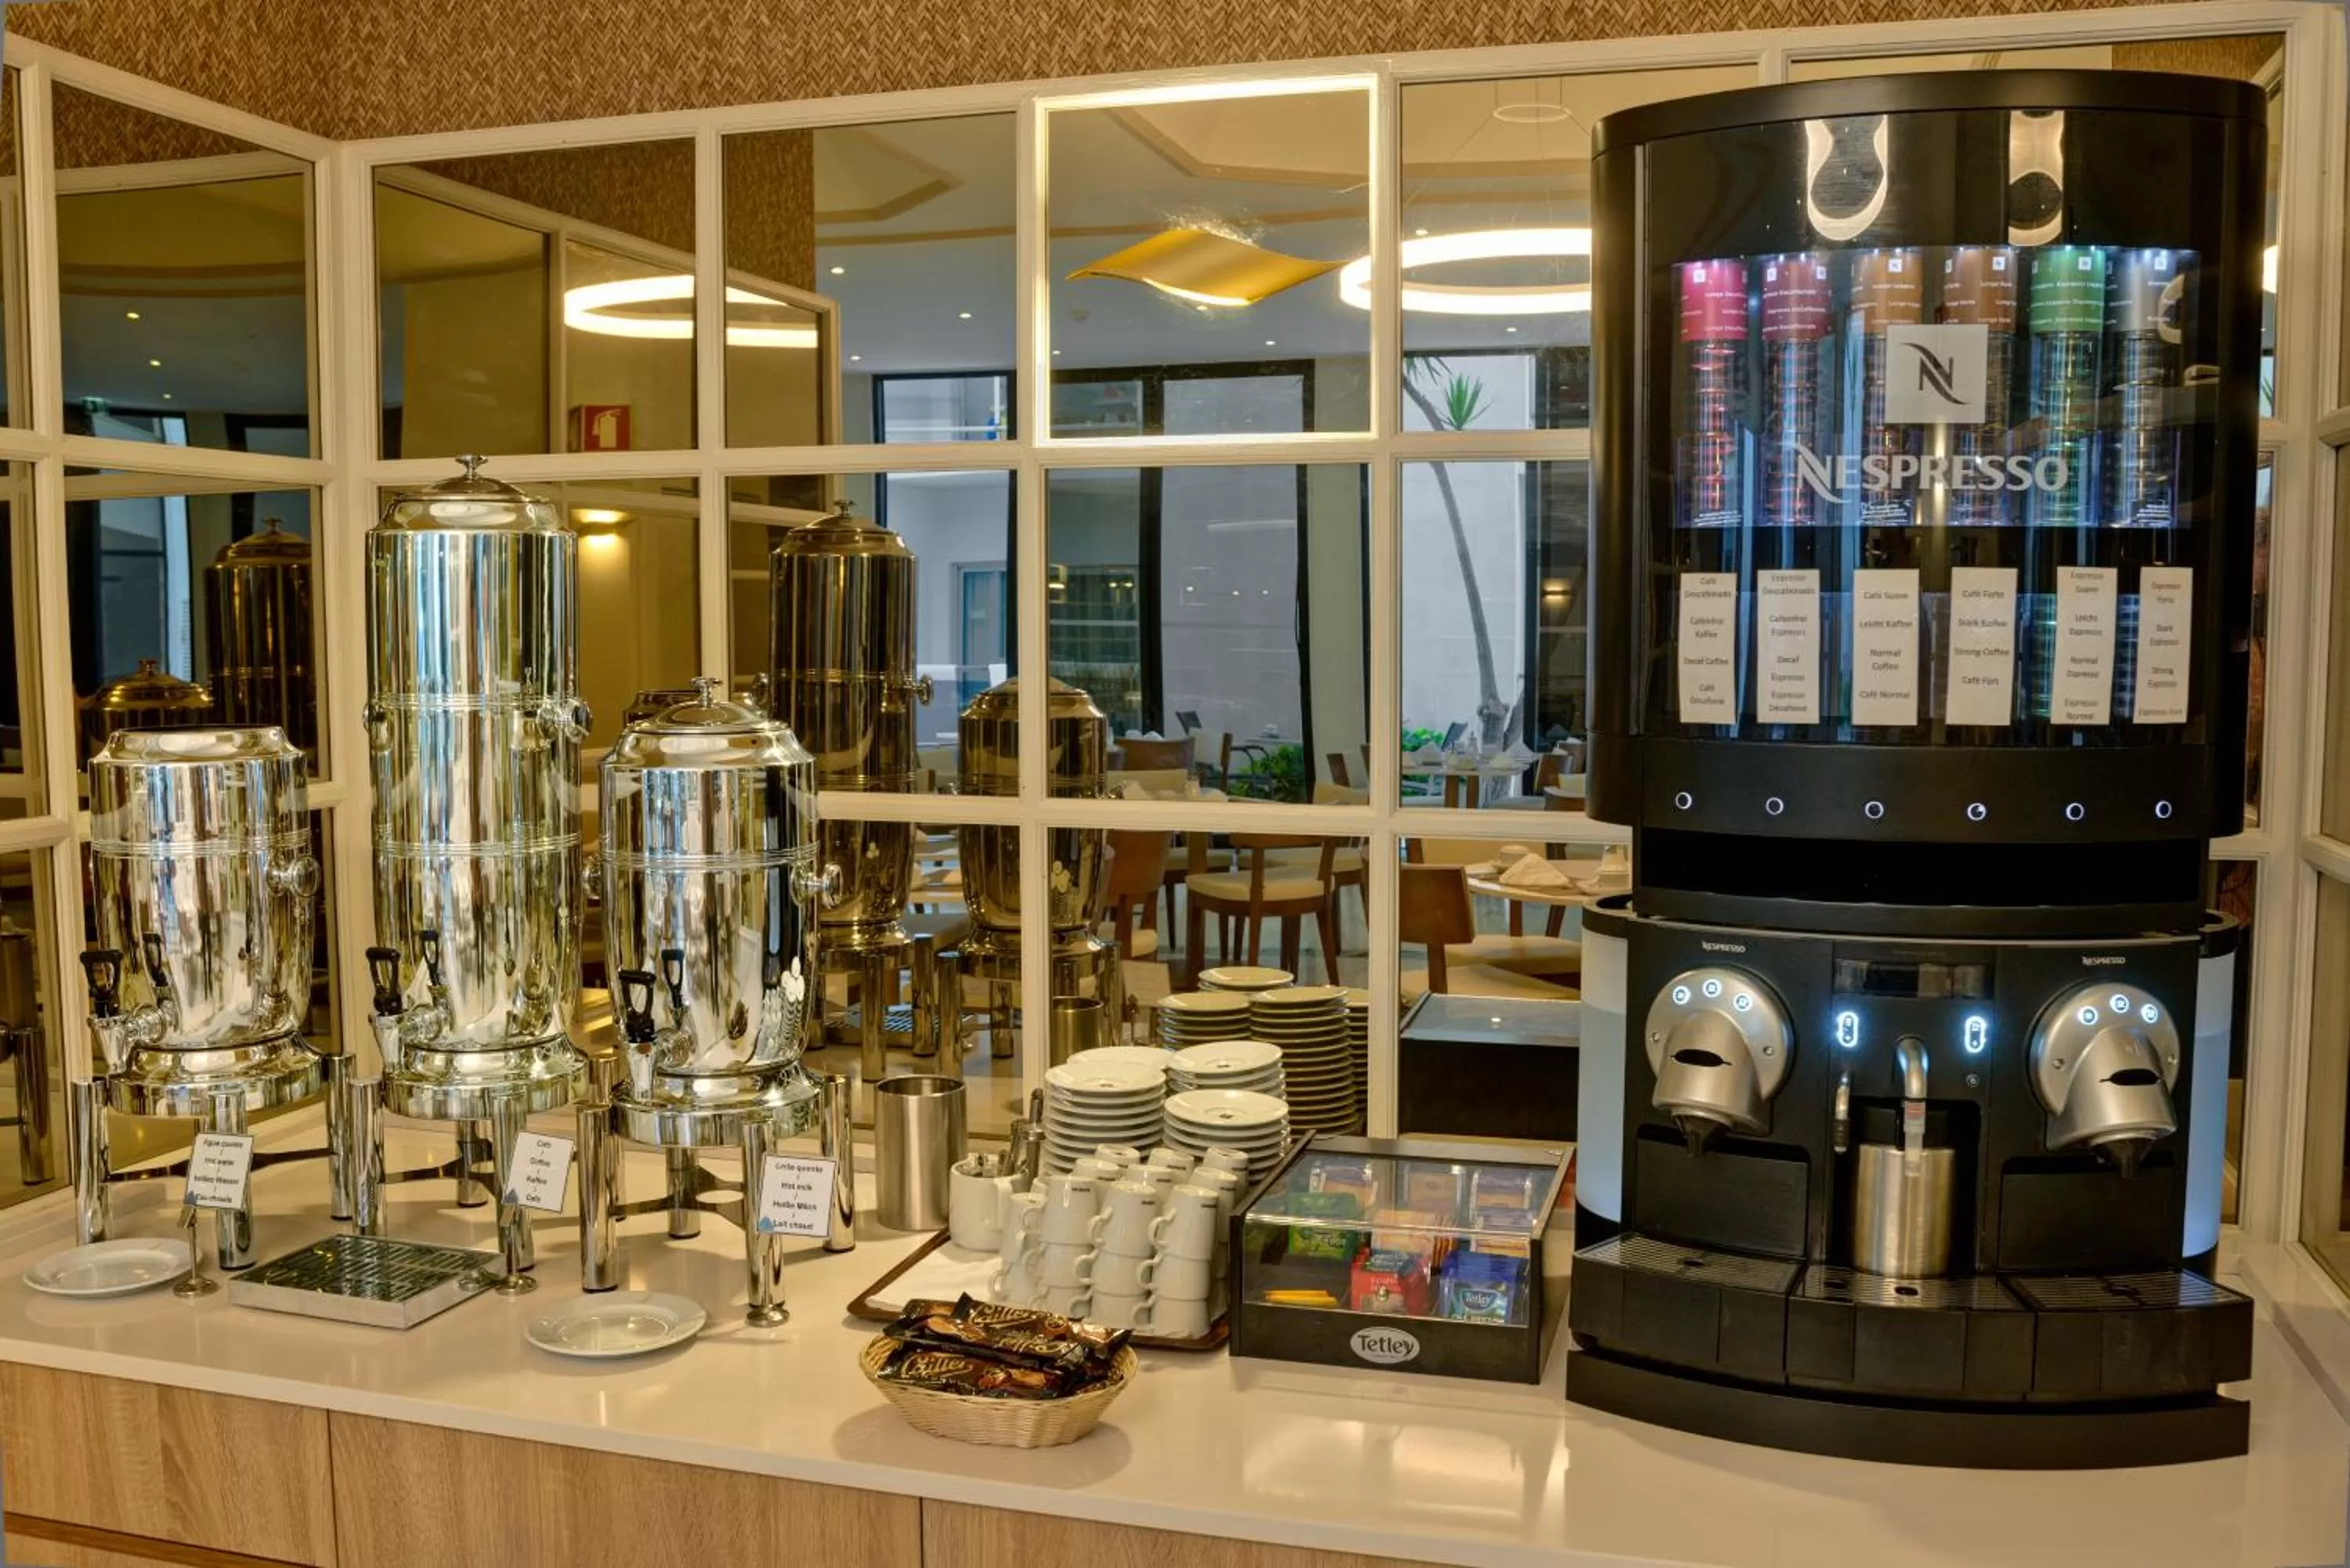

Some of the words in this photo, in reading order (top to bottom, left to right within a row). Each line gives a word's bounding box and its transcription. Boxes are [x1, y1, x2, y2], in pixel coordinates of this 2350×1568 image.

[1899, 342, 1972, 405] N
[1791, 443, 2069, 504] NESPRESSO
[1356, 1334, 1415, 1357] Tetley
